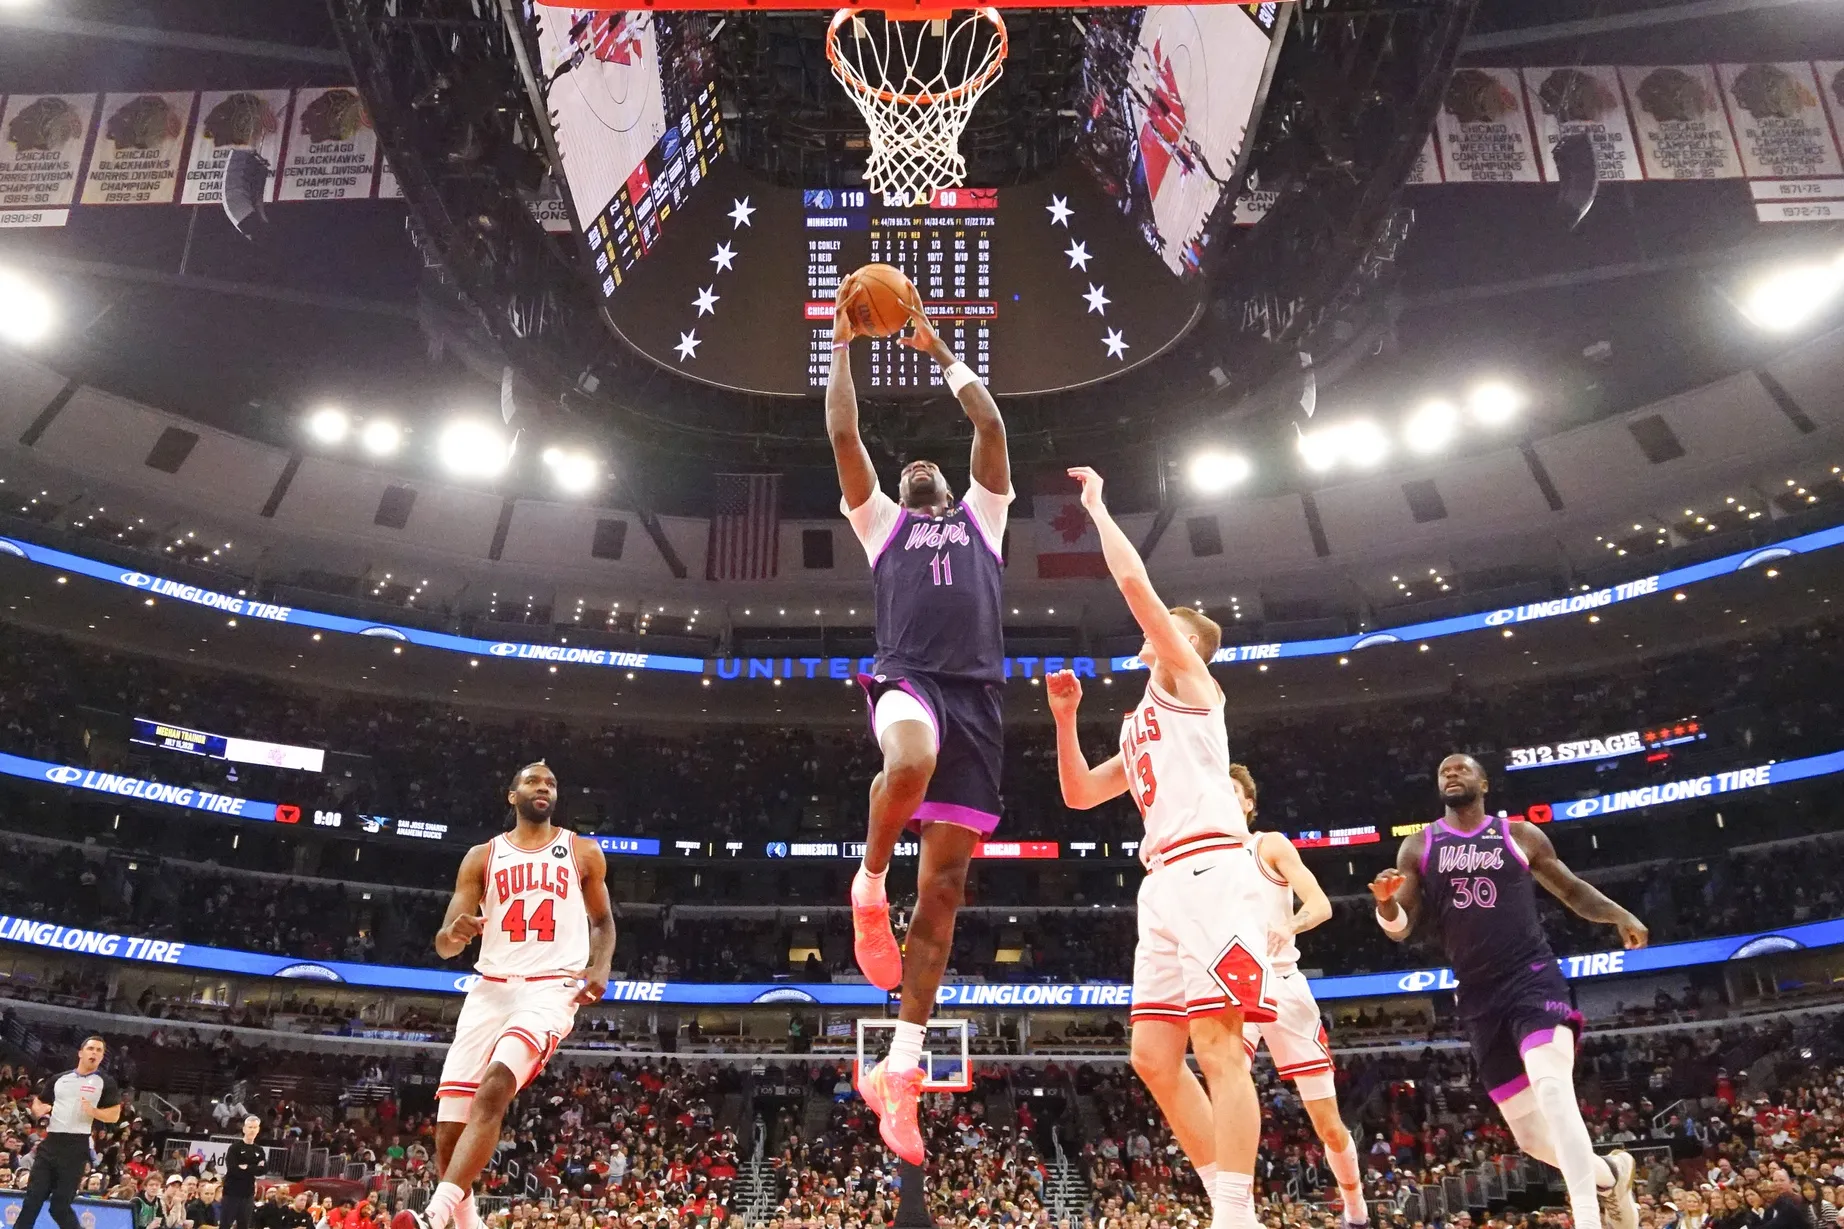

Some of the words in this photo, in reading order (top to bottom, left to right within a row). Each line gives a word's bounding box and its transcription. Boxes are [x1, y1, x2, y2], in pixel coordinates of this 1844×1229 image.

[309, 144, 354, 153] CHICAGO
[15, 151, 61, 162] CHICAGO
[115, 150, 160, 160] CHICAGO
[294, 155, 364, 165] BLACKHAWKS
[98, 160, 171, 170] BLACKHAWKS
[284, 167, 328, 177] CENTRAL
[332, 165, 373, 175] DIVISION
[1459, 162, 1523, 171] CHAMPIONS
[0, 173, 26, 184] ORRIS
[30, 172, 74, 182] DIVISION
[90, 171, 129, 181] NORRIS
[132, 169, 175, 180] DIVISION
[100, 181, 160, 192] CHAMPIONS
[296, 177, 357, 188] CHAMPIONS
[652, 172, 668, 205] 5:51
[304, 190, 345, 199] 2012-13
[841, 191, 865, 207] 119
[941, 191, 957, 207] 90
[807, 217, 848, 227] MINNESOTA
[818, 240, 841, 250] CONLEY
[872, 240, 878, 250] 17
[887, 240, 891, 250] 2
[900, 240, 904, 250] 2
[931, 240, 941, 250] 1/3
[810, 253, 816, 262] 11
[818, 253, 832, 262] REID
[899, 253, 906, 262] 31
[913, 253, 917, 262] 7
[808, 265, 816, 274] 22
[818, 265, 837, 274] CLARK
[914, 265, 917, 274] 1
[930, 265, 941, 274] 2/3
[978, 265, 989, 274] 2/2
[818, 277, 841, 286] RANDLE
[808, 306, 837, 316] CHICAG
[811, 341, 817, 350] 11
[886, 341, 891, 350] 2
[978, 341, 989, 350] 2/2
[810, 353, 817, 362] 13
[872, 353, 879, 362] 21
[887, 353, 890, 362] 1
[808, 365, 817, 374] 44
[900, 365, 904, 374] 4
[914, 365, 917, 374] 1
[810, 377, 817, 386] 14
[871, 377, 880, 386] 23
[886, 377, 891, 386] 2
[899, 377, 906, 386] 13
[929, 551, 953, 585] 11
[150, 577, 244, 613] LINGLONG
[247, 600, 292, 621] TIRE
[1517, 589, 1612, 621] LINGLONG
[1614, 575, 1660, 601] TIRE
[518, 644, 606, 664] LINGLONG
[609, 651, 649, 667] TIRE
[1239, 643, 1282, 660] TIRE
[156, 725, 181, 740] MEGHAN
[1557, 731, 1641, 761] STAGE
[81, 771, 194, 806] LINGLONG
[196, 791, 247, 816] TIRE
[1602, 775, 1713, 813] LINGLONG
[1716, 765, 1772, 793] TIRE
[398, 819, 410, 829] SAN
[410, 821, 425, 831] JOSE
[425, 823, 447, 833] SHARKS
[1329, 826, 1375, 837] TIMBERWOLVES
[397, 827, 422, 837] ANAHEIM
[422, 831, 442, 840] DUCKS
[601, 840, 638, 851] CLUB
[790, 843, 838, 856] MINNESOTA
[893, 843, 918, 856] 5:51
[983, 843, 1021, 856] CHICAGO
[1438, 844, 1504, 874] Wolves
[495, 862, 569, 905] BULLS
[1451, 876, 1497, 909] 30
[501, 898, 555, 943] 44
[0, 916, 121, 955] LINGLONG
[120, 936, 185, 963] TIRE
[1568, 951, 1625, 977] TIRE
[613, 981, 667, 1001] TIRE
[960, 985, 1074, 1004] LINGLONG
[1075, 985, 1134, 1004] TIRE
